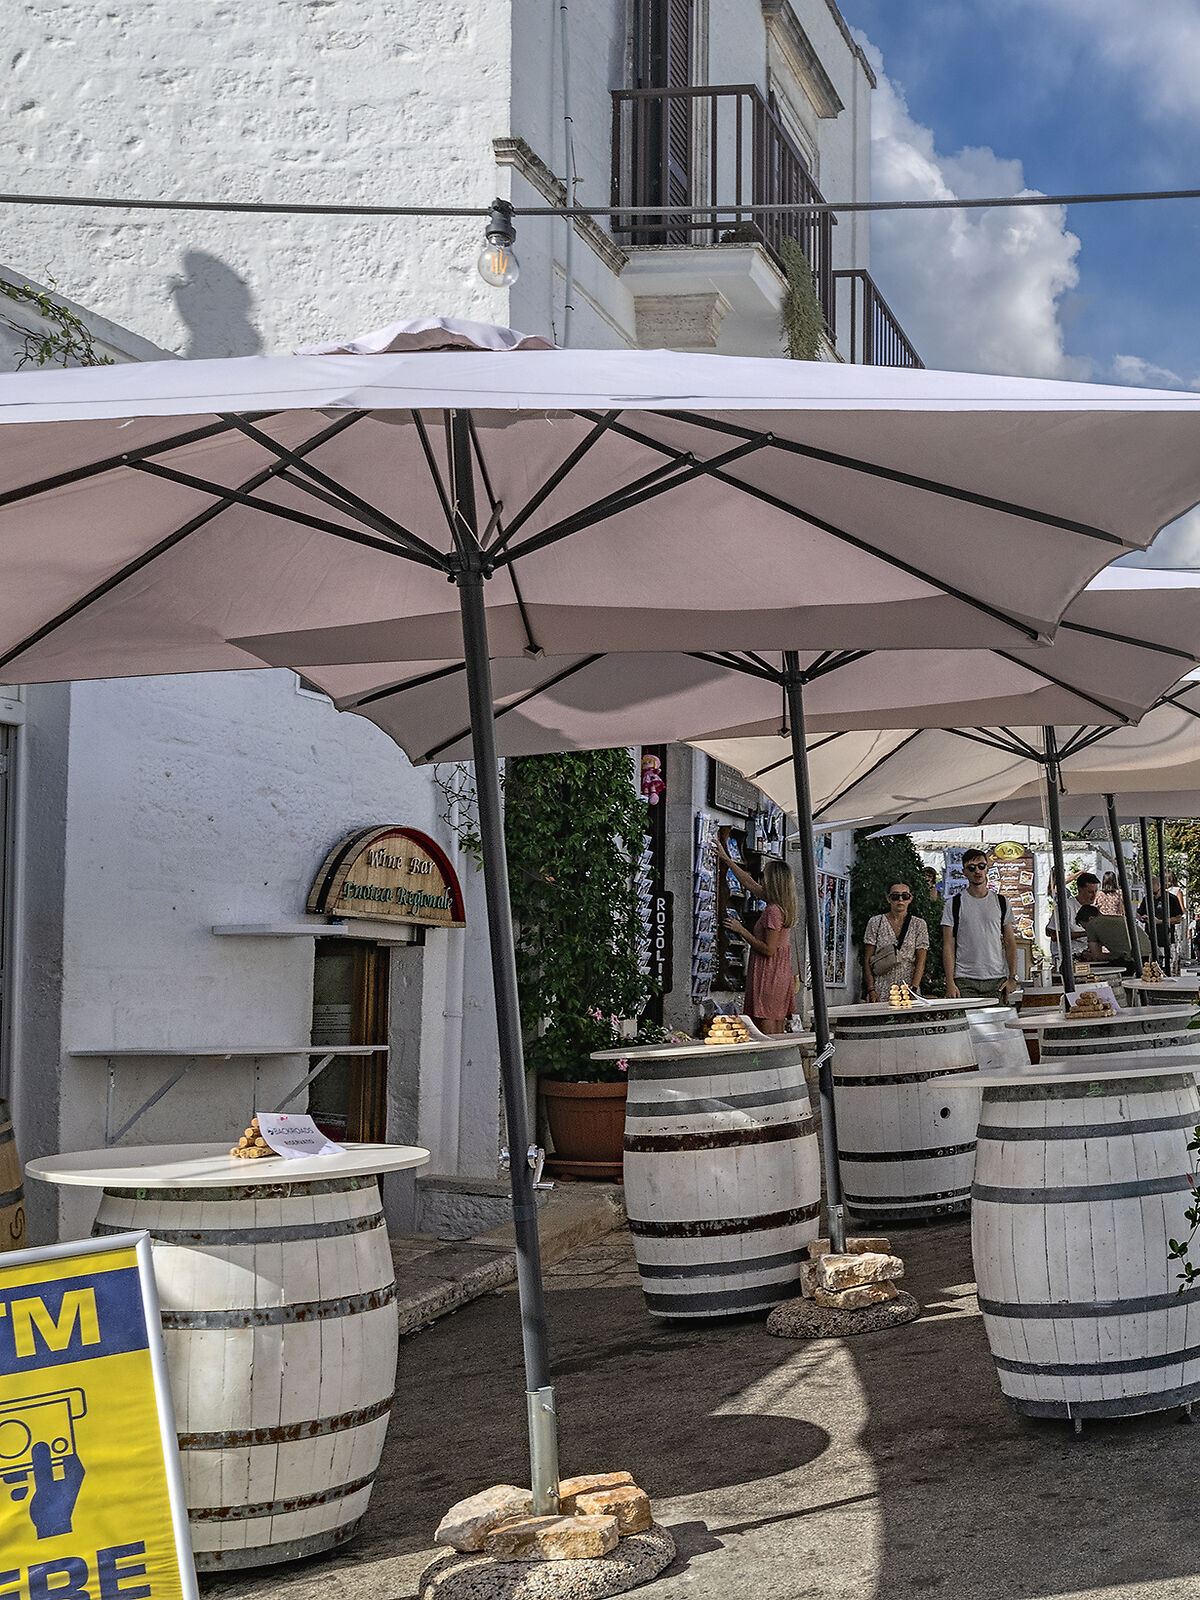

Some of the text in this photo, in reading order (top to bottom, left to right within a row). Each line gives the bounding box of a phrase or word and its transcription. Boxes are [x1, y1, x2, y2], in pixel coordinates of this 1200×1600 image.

[367, 848, 436, 875] Wine Bar
[343, 880, 454, 915] Enoteca Regionale
[0, 1287, 101, 1358] M
